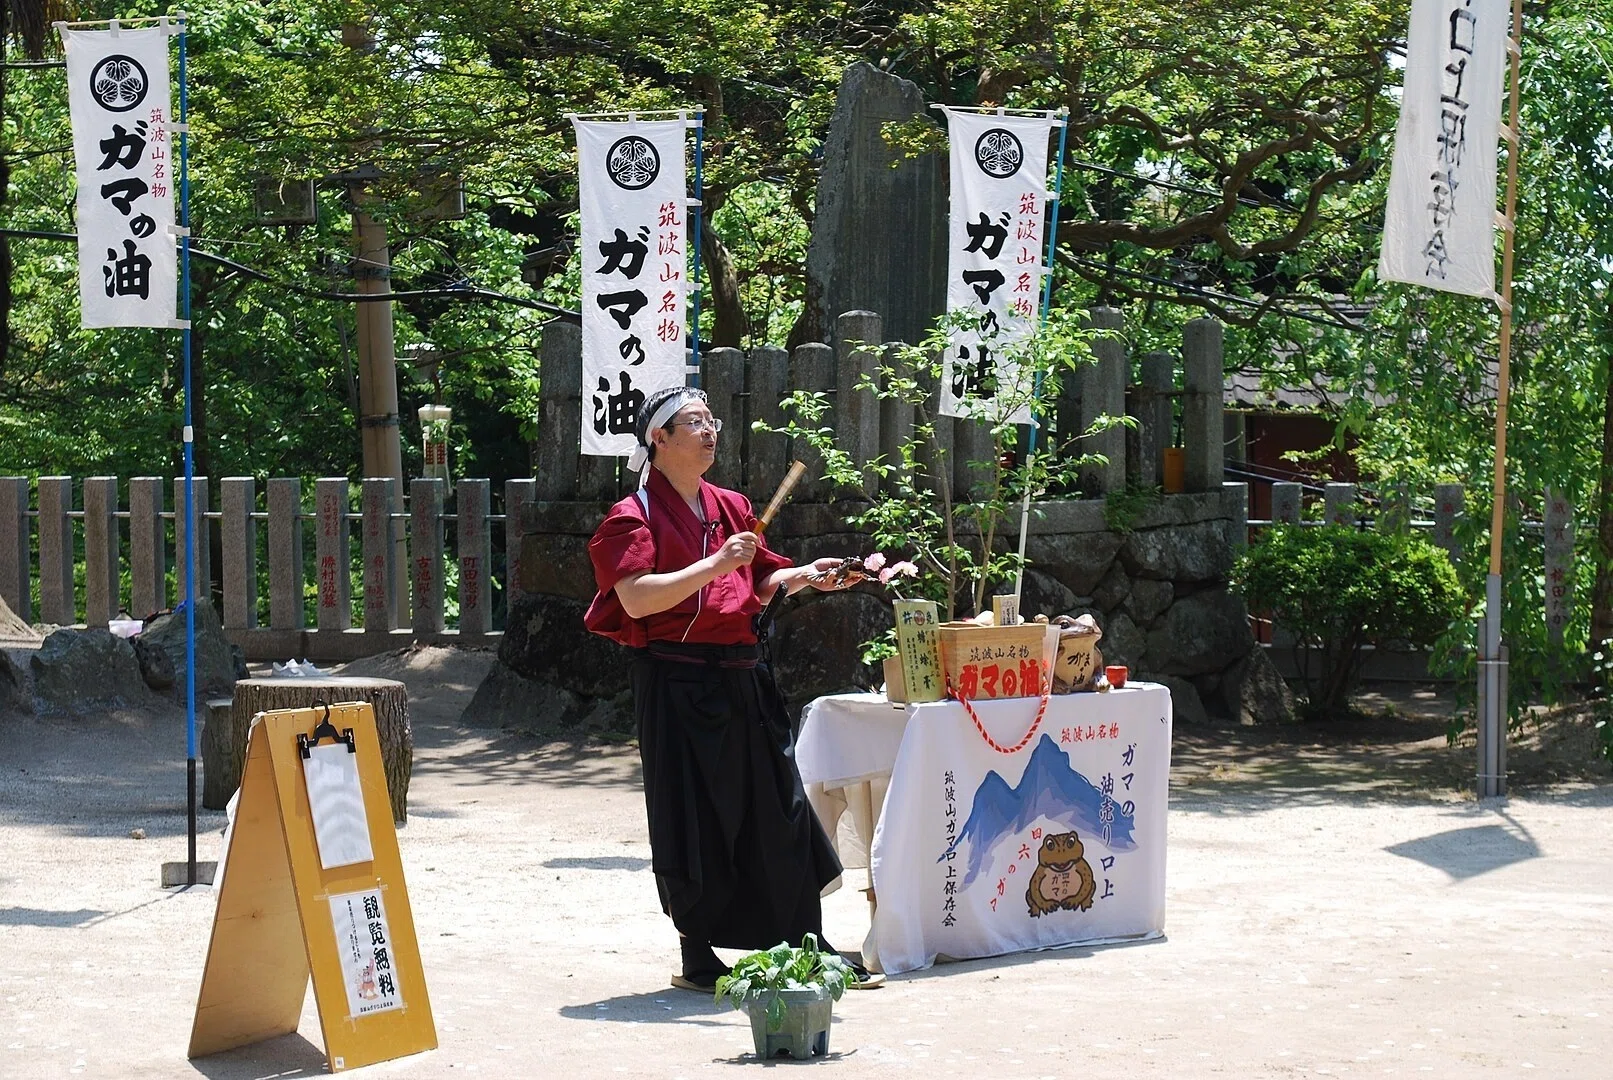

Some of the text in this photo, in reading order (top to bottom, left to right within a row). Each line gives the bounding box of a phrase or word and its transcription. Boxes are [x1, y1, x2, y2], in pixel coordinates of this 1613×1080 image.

[150, 108, 167, 198] 筑波山名物
[97, 119, 156, 301] ガマの油
[1012, 192, 1039, 317] 筑波山名物
[657, 202, 681, 344] 筑波山名物
[592, 226, 651, 436] ガマの油
[959, 658, 1040, 698] ガマの油
[969, 644, 1030, 662] 筑波山名物
[1060, 722, 1120, 744] 筑波山名物
[1121, 742, 1138, 818] ガマの
[941, 770, 958, 928] 筑波山ガマ口上保存会
[990, 827, 1043, 912] 四六のガマ
[1099, 772, 1115, 900] 油売り口上
[363, 895, 396, 998] 観覧無料
